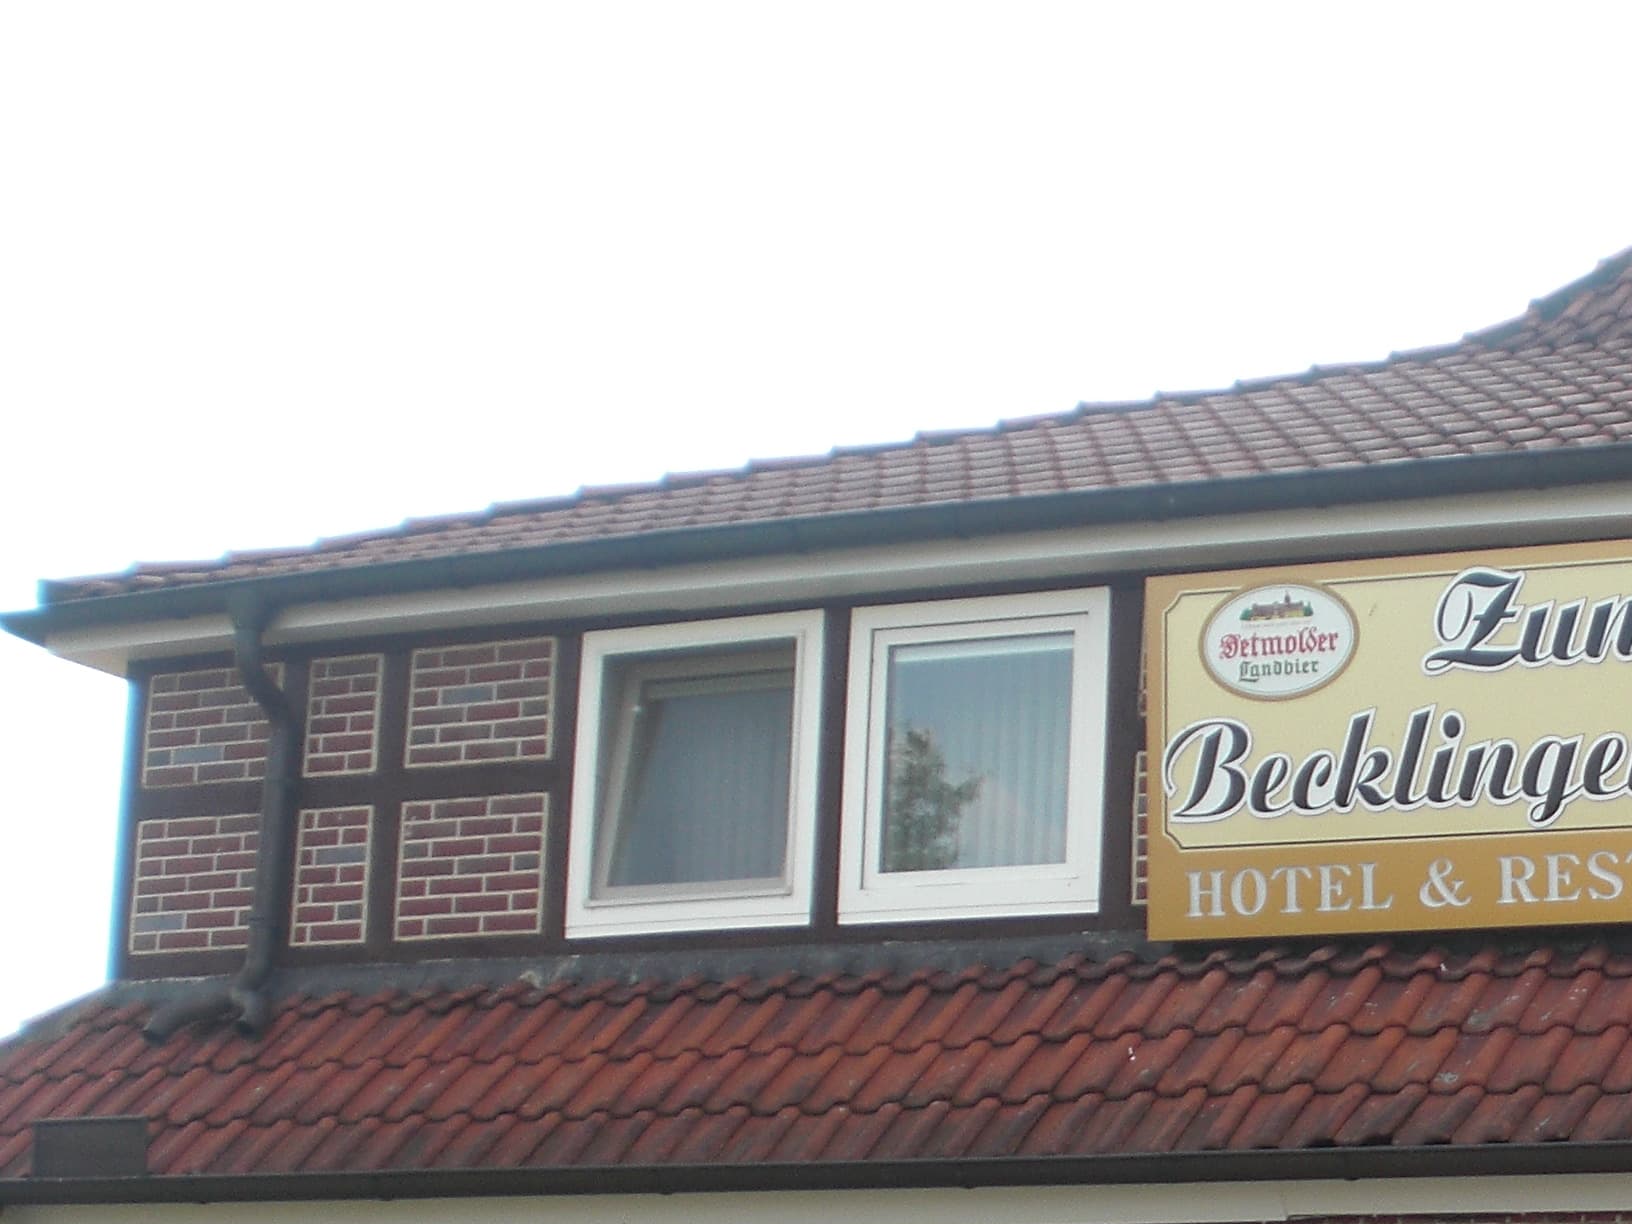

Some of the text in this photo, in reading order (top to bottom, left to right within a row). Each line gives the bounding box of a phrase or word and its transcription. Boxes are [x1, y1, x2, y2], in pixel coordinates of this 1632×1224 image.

[1219, 626, 1339, 660] Detmolder
[1239, 657, 1320, 683] Landbier
[1185, 862, 1394, 918] HOTEL
[1418, 857, 1472, 910] &
